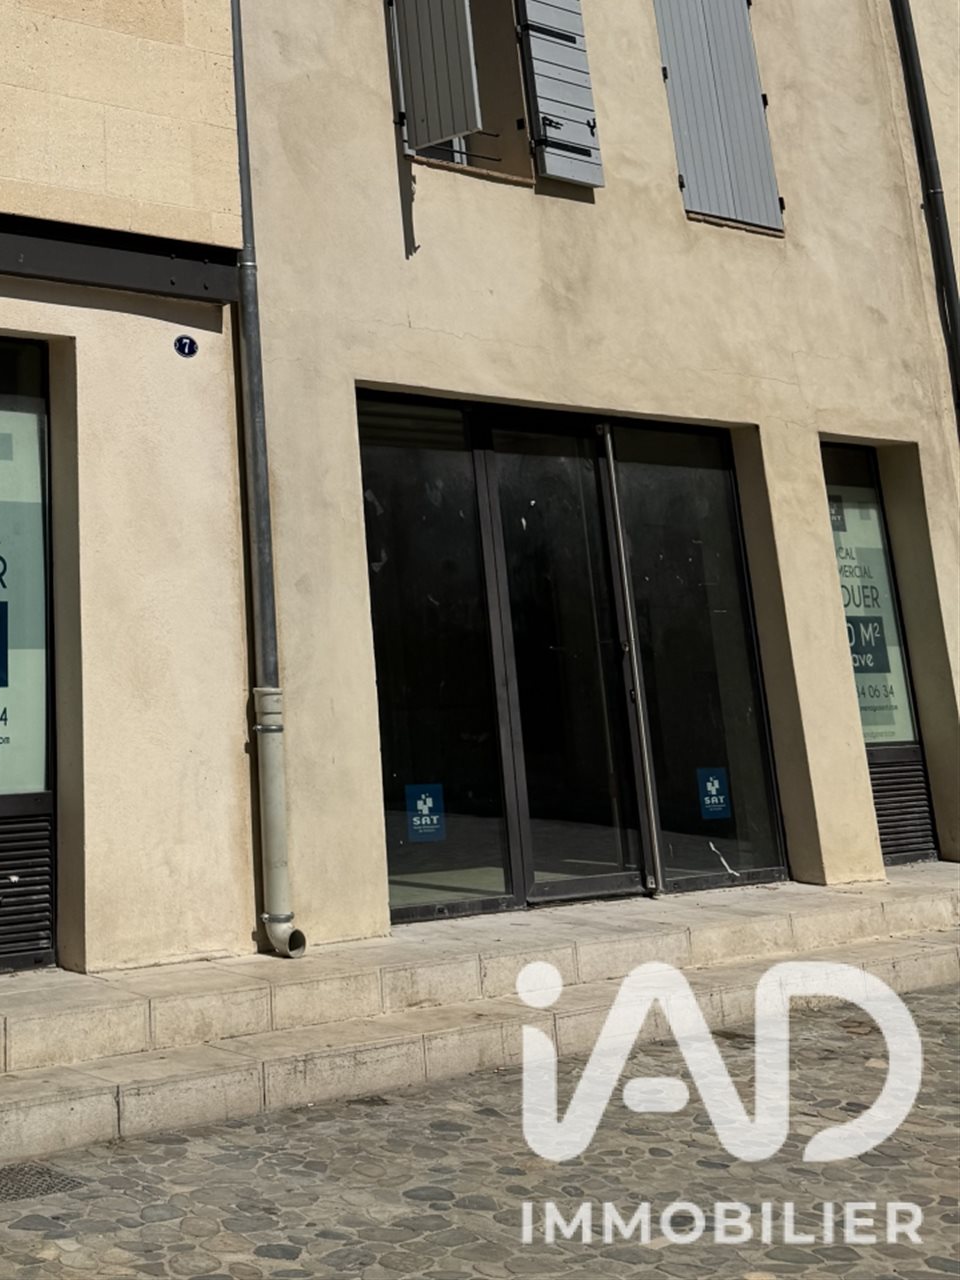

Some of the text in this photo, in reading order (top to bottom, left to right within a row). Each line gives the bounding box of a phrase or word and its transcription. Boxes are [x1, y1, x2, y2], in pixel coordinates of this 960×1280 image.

[182, 338, 191, 354] 7
[852, 653, 874, 668] ave
[868, 684, 881, 699] 06
[882, 684, 895, 699] 34
[704, 795, 725, 805] SAT
[412, 815, 440, 825] SAT
